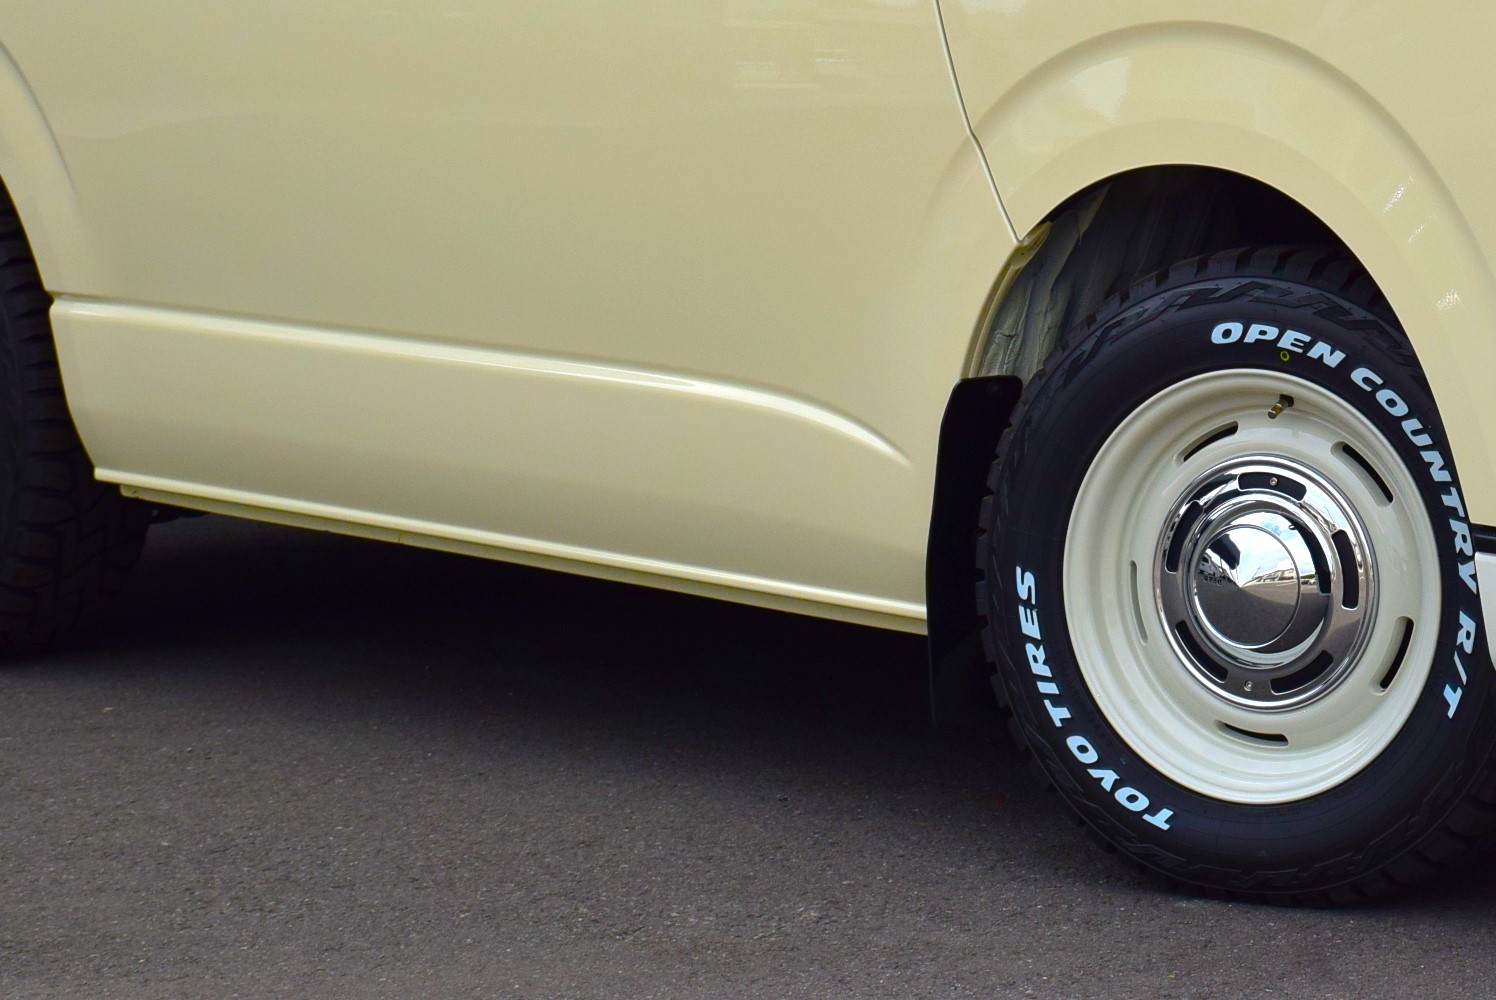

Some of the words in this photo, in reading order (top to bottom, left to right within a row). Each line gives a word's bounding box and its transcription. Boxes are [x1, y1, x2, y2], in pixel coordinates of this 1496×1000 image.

[1210, 321, 1347, 369] OPEN
[1350, 367, 1478, 596] COUNTRY
[1442, 609, 1477, 719] R/T
[1015, 565, 1072, 728] TIRES
[1065, 734, 1174, 831] TOYO
